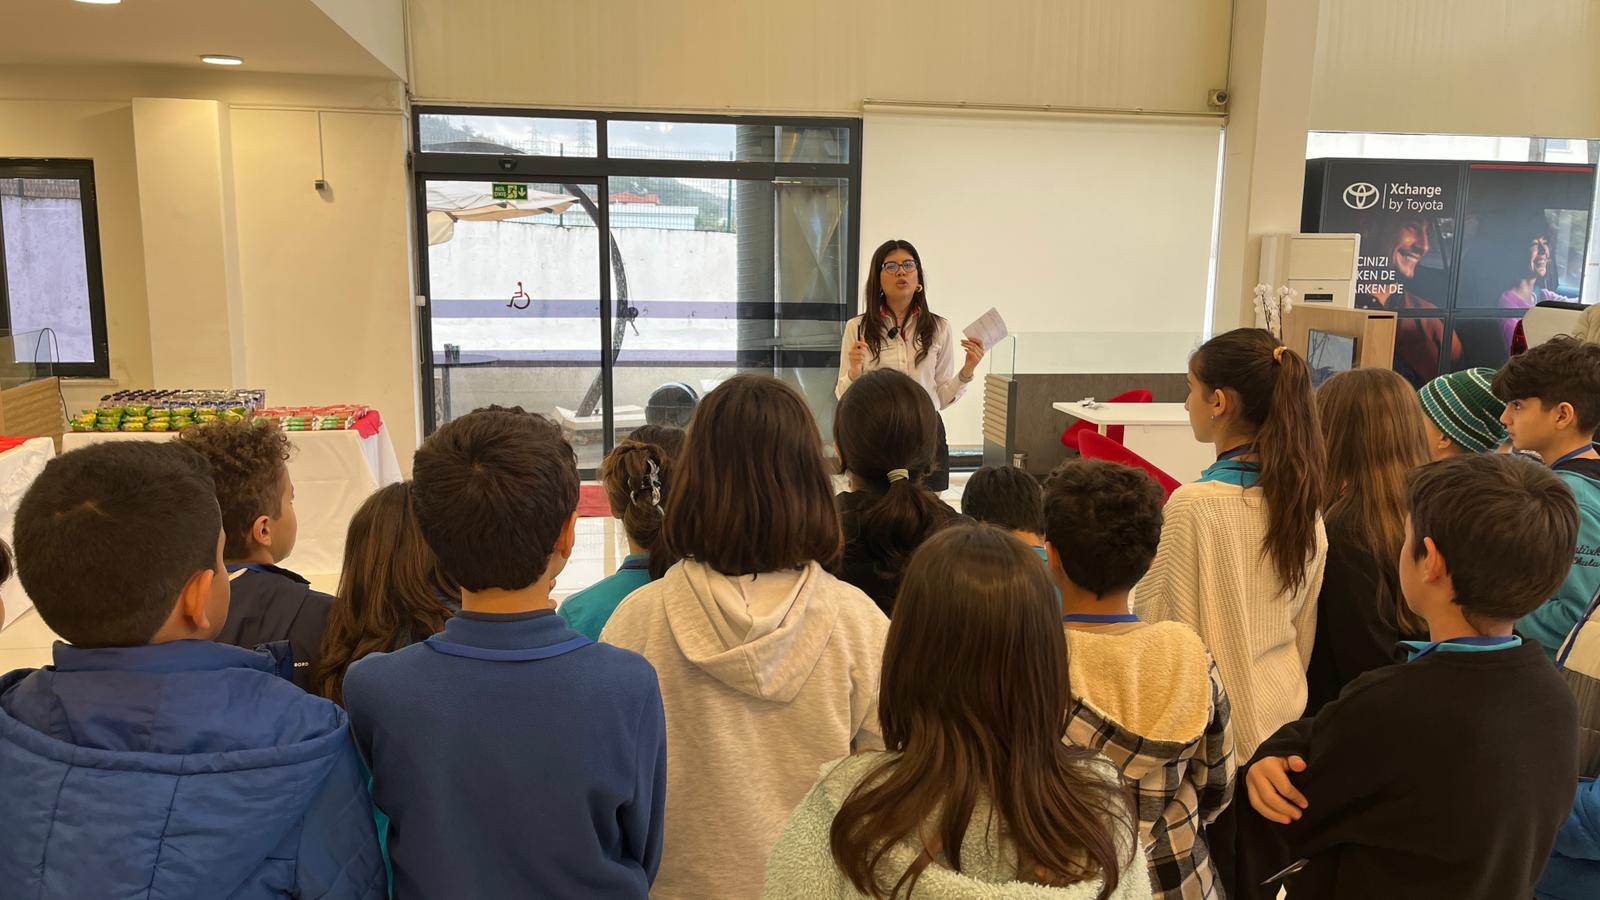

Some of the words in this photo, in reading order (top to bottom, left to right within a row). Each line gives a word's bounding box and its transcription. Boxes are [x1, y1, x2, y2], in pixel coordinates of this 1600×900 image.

[1390, 183, 1442, 198] Xchange
[1389, 198, 1403, 212] by
[1406, 198, 1444, 212] Toyota
[1381, 270, 1396, 280] DE
[1389, 284, 1404, 294] DE
